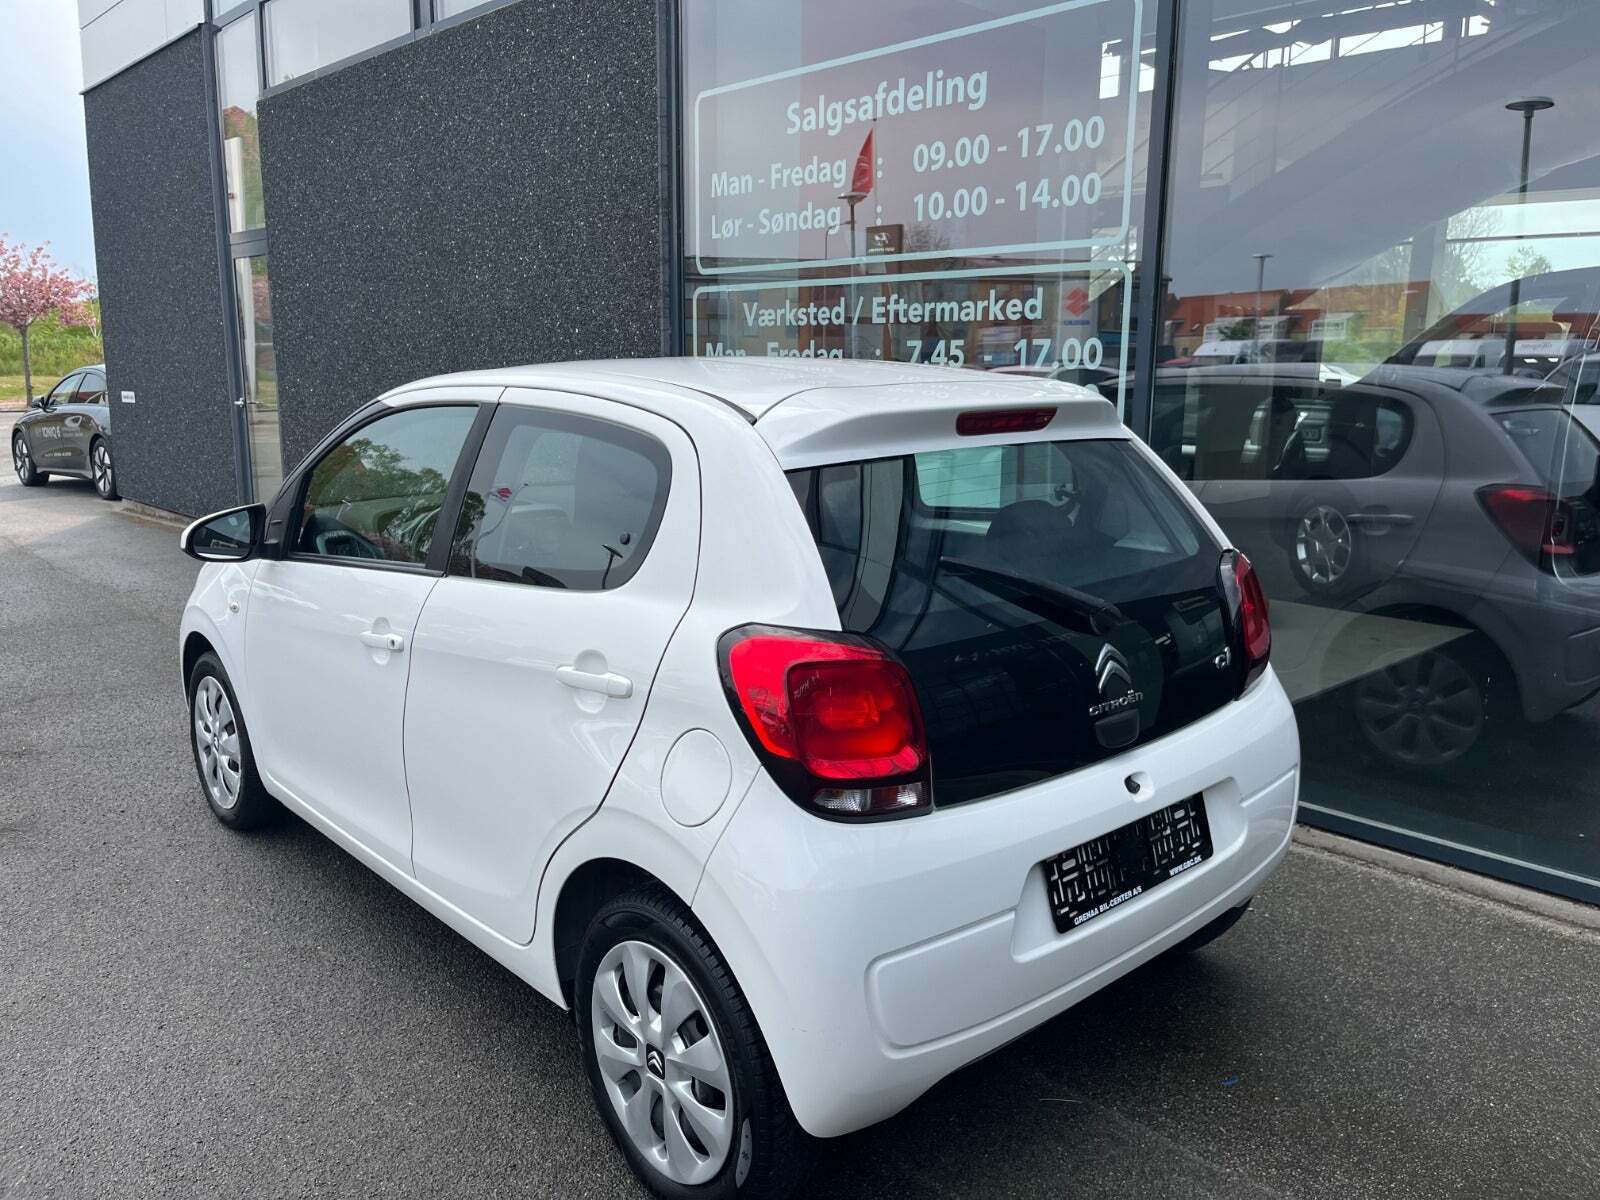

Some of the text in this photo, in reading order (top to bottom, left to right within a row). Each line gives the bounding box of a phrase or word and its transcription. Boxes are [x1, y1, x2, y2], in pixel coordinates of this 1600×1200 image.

[786, 69, 988, 136] Salgsafdeling
[711, 171, 752, 198] Man
[771, 155, 847, 188] Fredag
[912, 134, 990, 172] 09.00
[1017, 115, 1105, 158] 17.00
[711, 214, 742, 239] Lør
[758, 202, 841, 235] Søndag
[913, 186, 988, 222] 10.00
[1015, 172, 1101, 211] 14.00
[742, 286, 1044, 328] Værksted / Eftermarked
[906, 339, 966, 368] 7.45
[1014, 337, 1103, 369] 17.00
[1089, 689, 1144, 716] CITROËN
